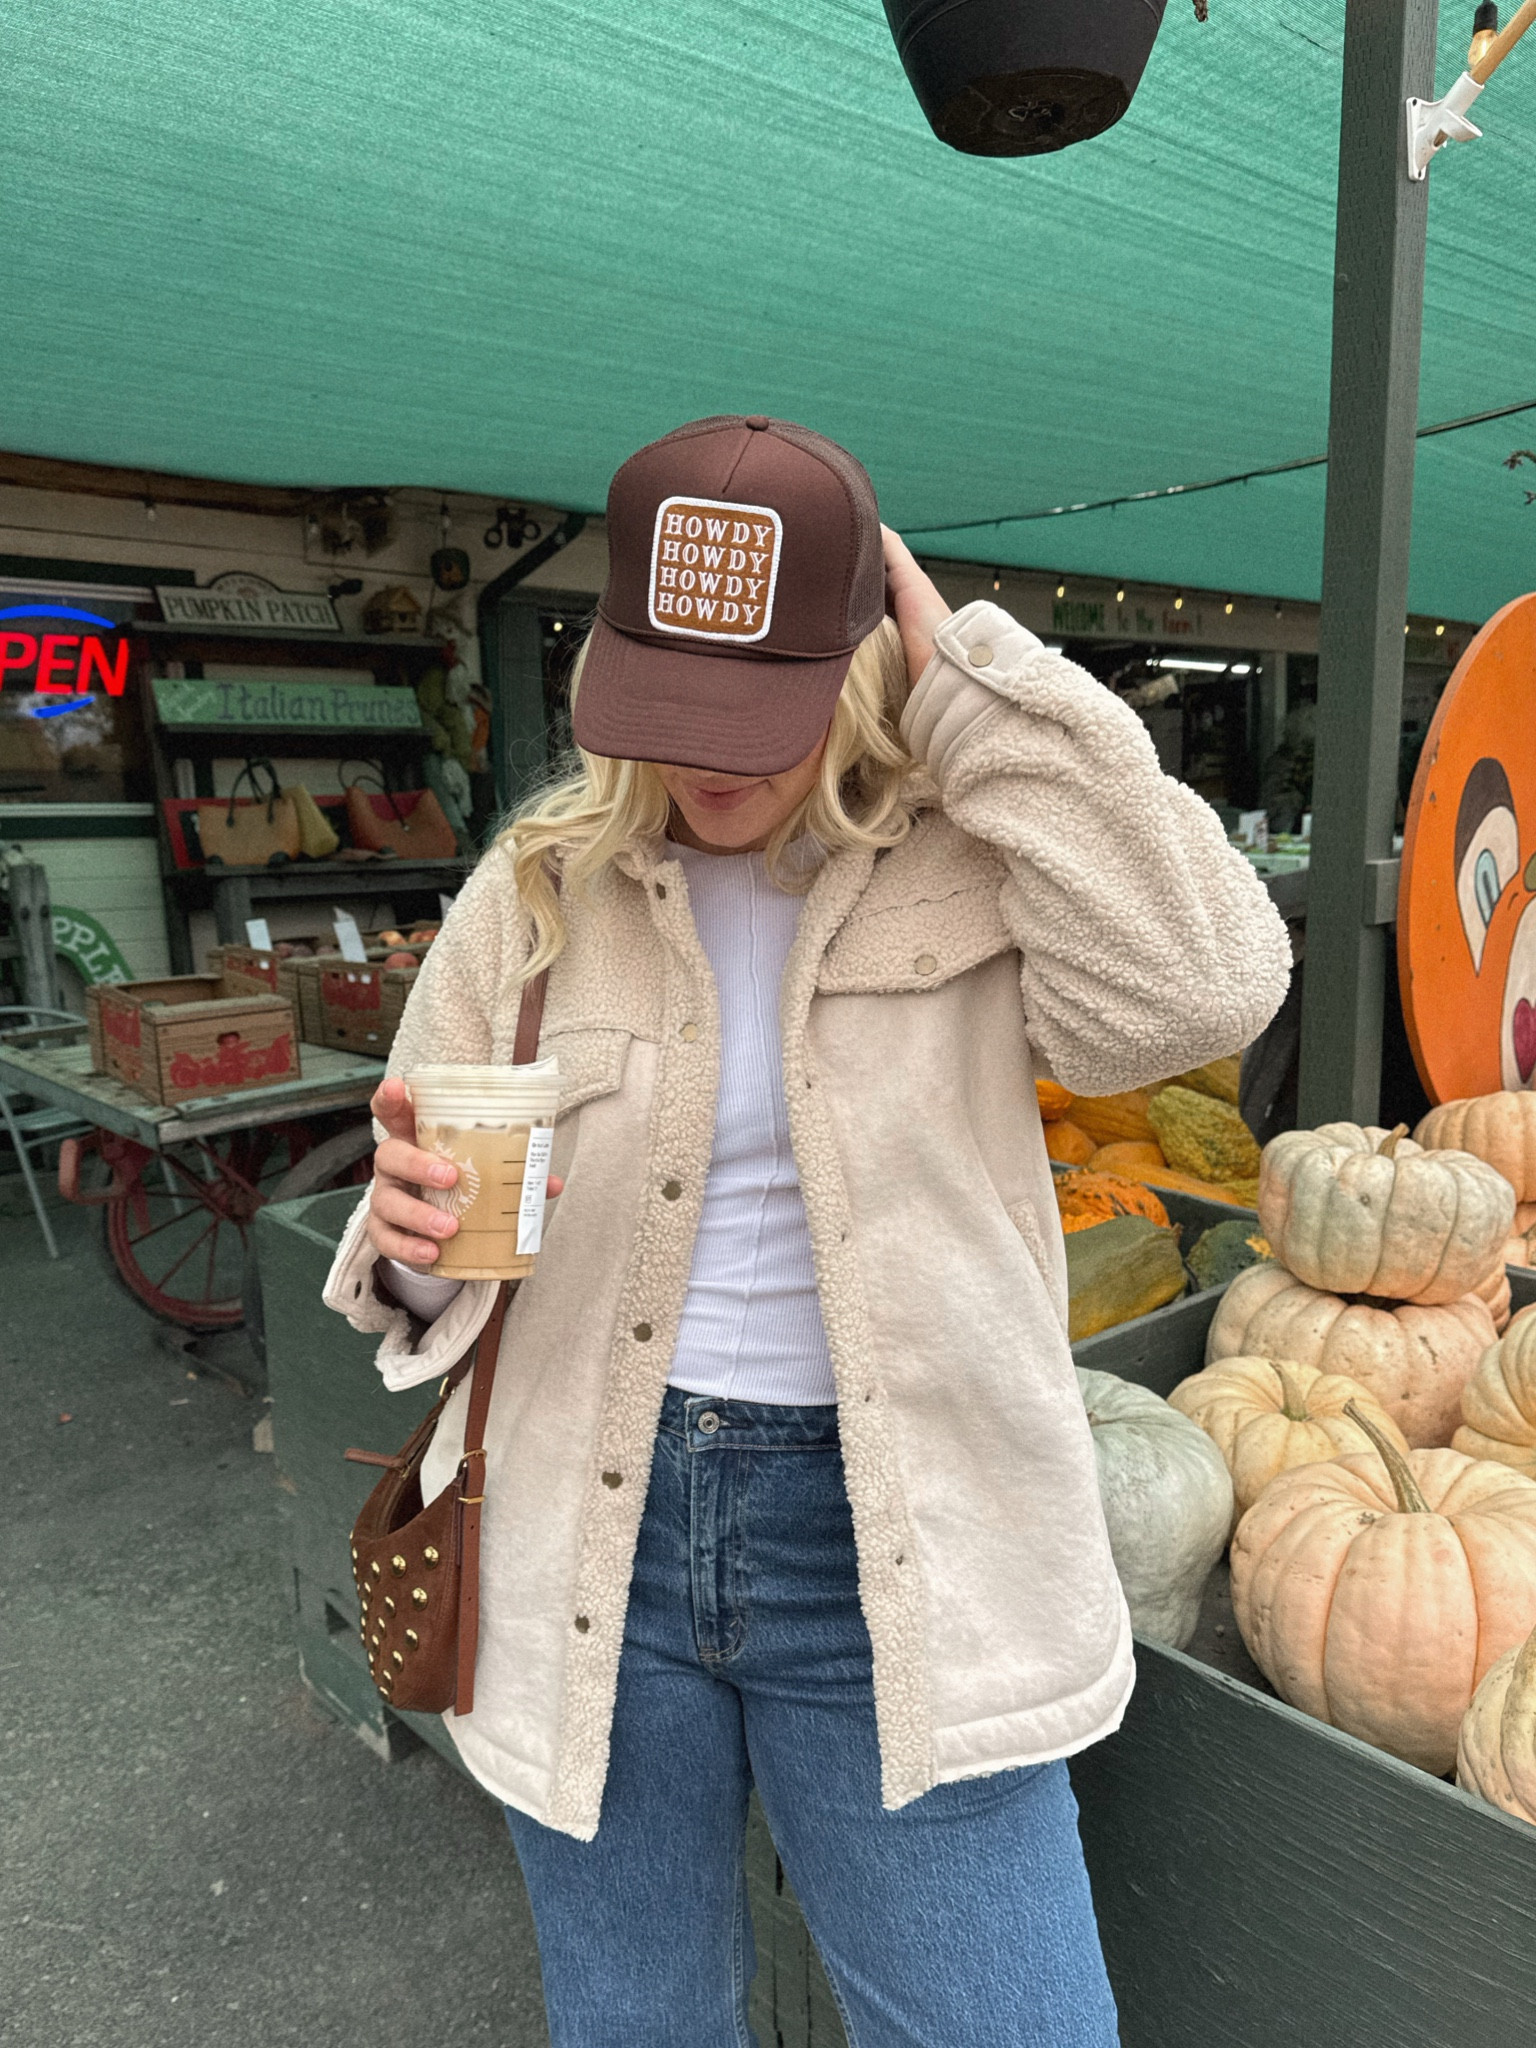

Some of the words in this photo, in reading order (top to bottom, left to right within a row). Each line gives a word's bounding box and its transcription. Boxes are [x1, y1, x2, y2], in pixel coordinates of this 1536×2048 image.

[664, 513, 773, 547] HOWDY
[662, 539, 769, 574] HOWDY
[659, 566, 765, 600] HOWDY
[163, 595, 263, 622] PUMPKIN
[266, 601, 334, 626] PATCH
[657, 592, 761, 626] HOWDY
[216, 683, 328, 721] Italian
[330, 687, 420, 725] Prunes
